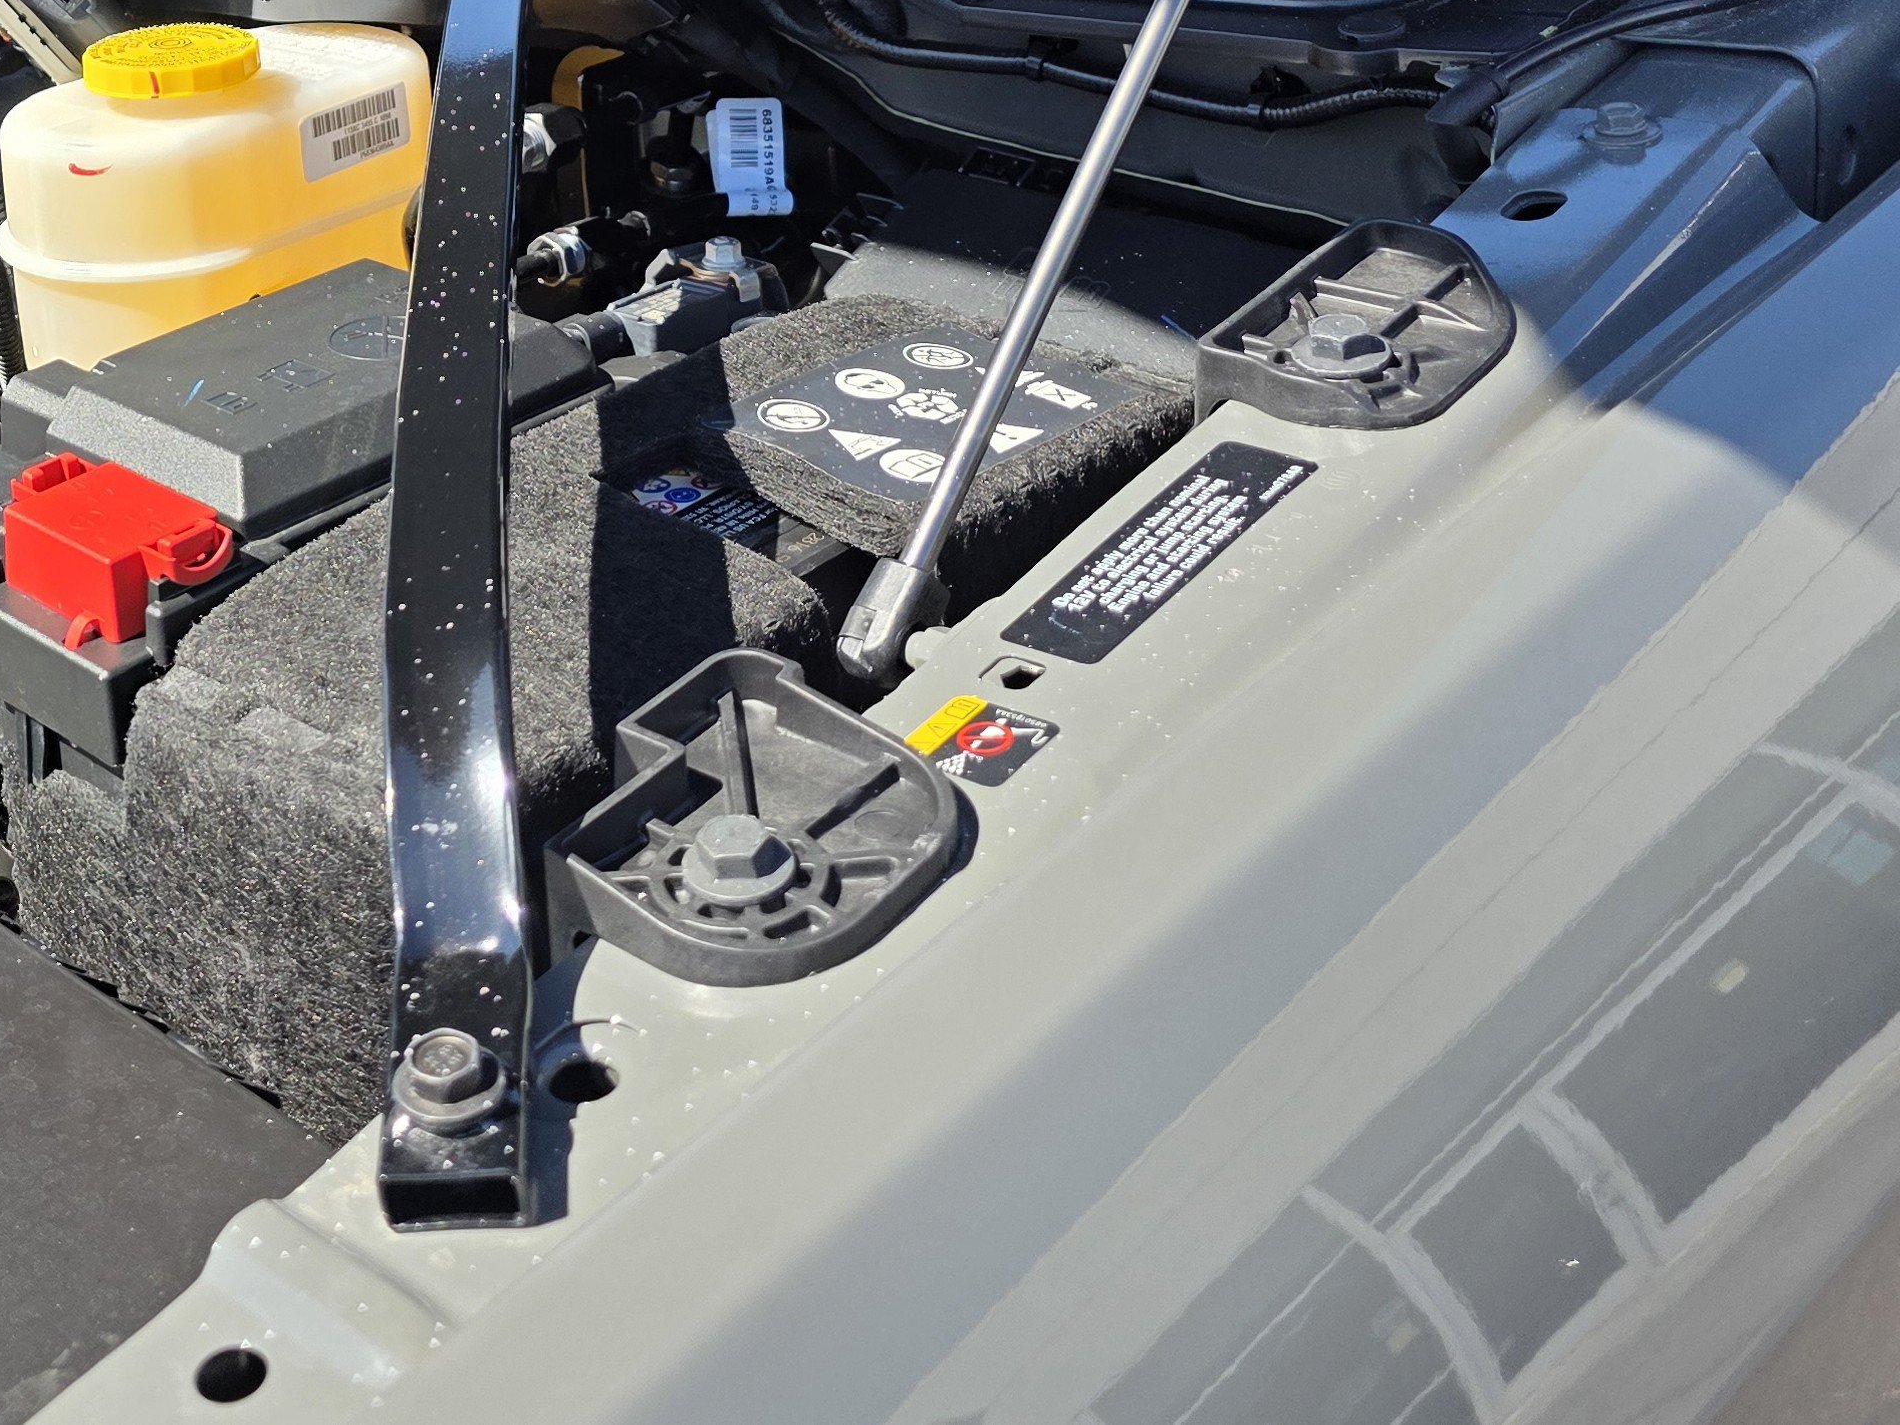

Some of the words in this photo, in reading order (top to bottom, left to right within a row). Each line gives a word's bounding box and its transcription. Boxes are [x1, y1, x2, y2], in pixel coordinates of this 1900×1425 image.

[1106, 535, 1160, 580] electrical
[1154, 505, 1196, 538] system
[1189, 478, 1230, 507] during
[1118, 528, 1149, 553] more
[1143, 507, 1174, 530] than
[1168, 474, 1211, 508] nominal
[1099, 564, 1150, 605] charging
[1152, 531, 1186, 556] jump
[1107, 579, 1151, 613] Engine
[1146, 562, 1171, 581] and
[1165, 525, 1215, 564] starting
[1207, 495, 1248, 526] system
[1142, 568, 1185, 601] failure
[1179, 544, 1213, 571] could
